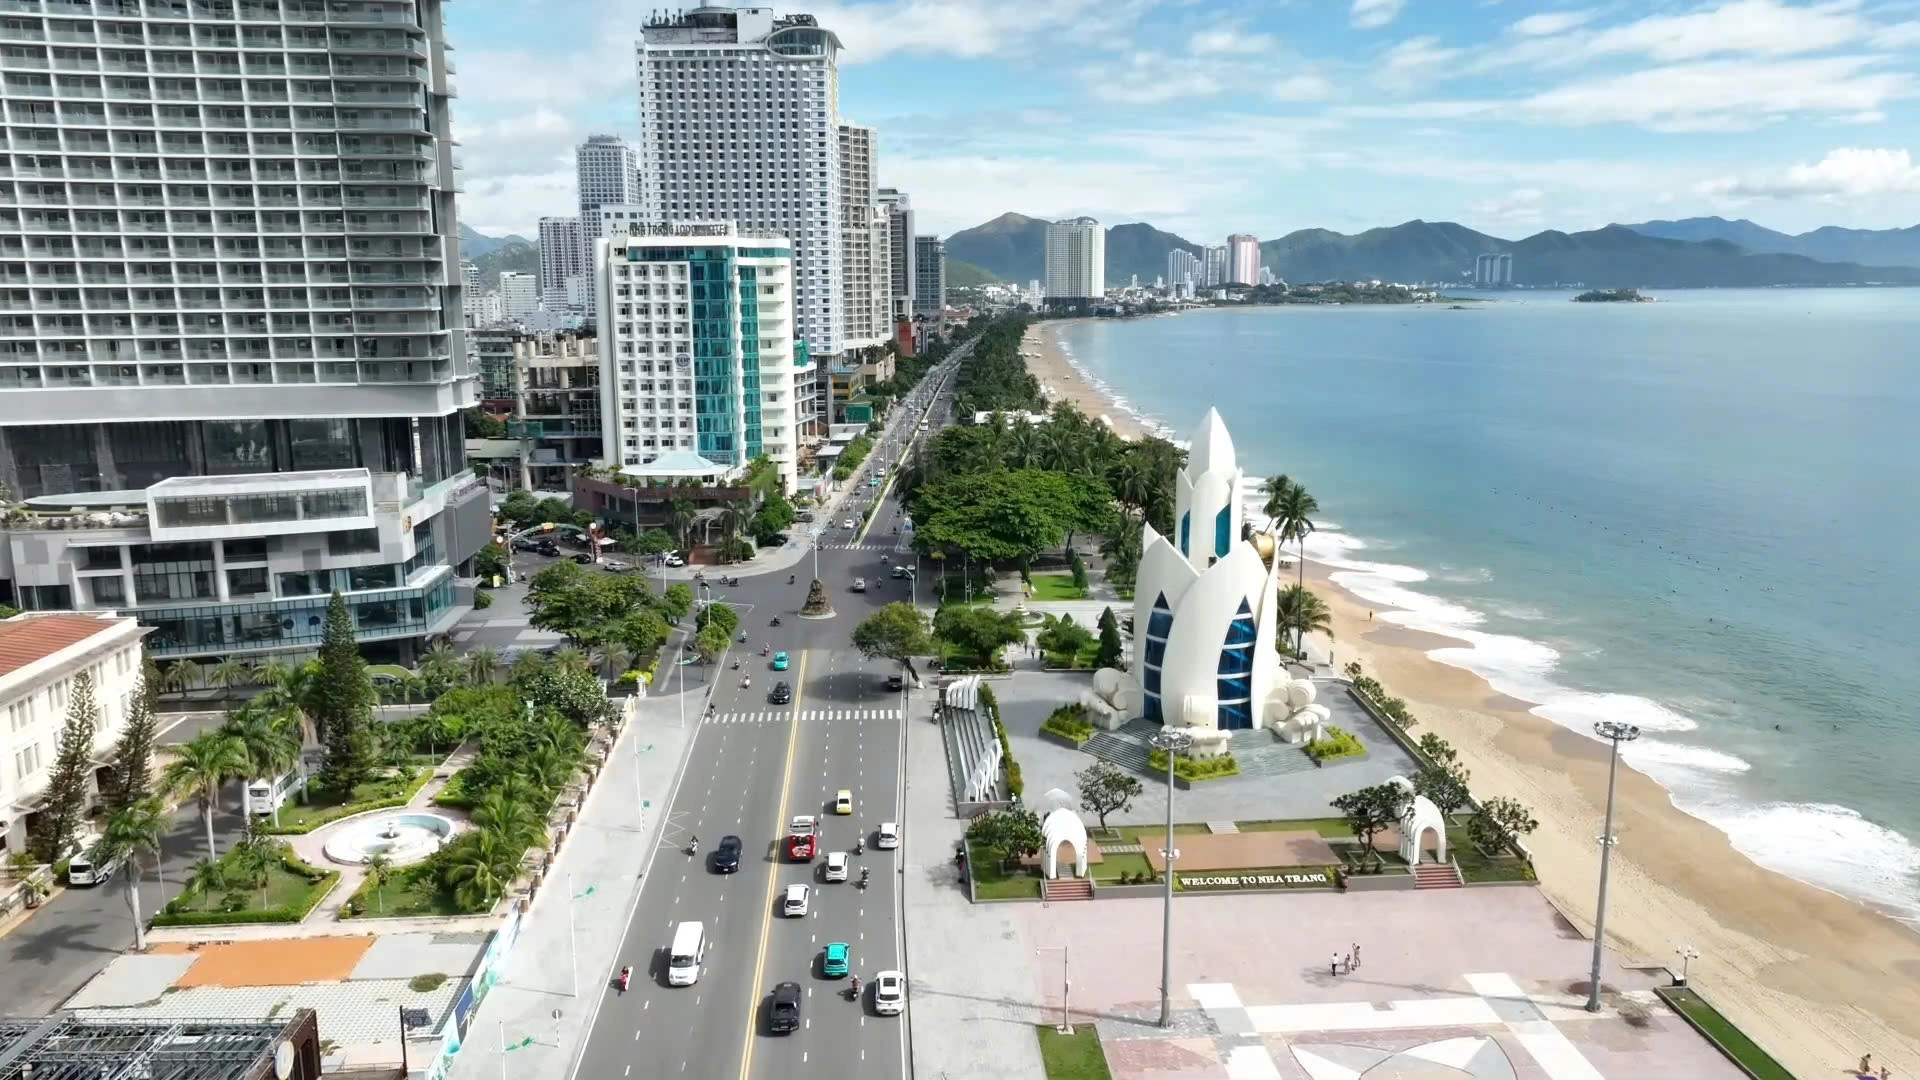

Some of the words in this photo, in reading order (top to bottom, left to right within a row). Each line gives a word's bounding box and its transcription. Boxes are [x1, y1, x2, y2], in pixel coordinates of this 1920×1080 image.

[629, 224, 646, 236] NHA
[647, 224, 673, 236] TRANG
[703, 224, 728, 236] OTEL
[1181, 876, 1239, 886] WELCOME
[1241, 875, 1256, 884] TO
[1258, 875, 1284, 884] NHA
[1285, 874, 1326, 883] TRANG
